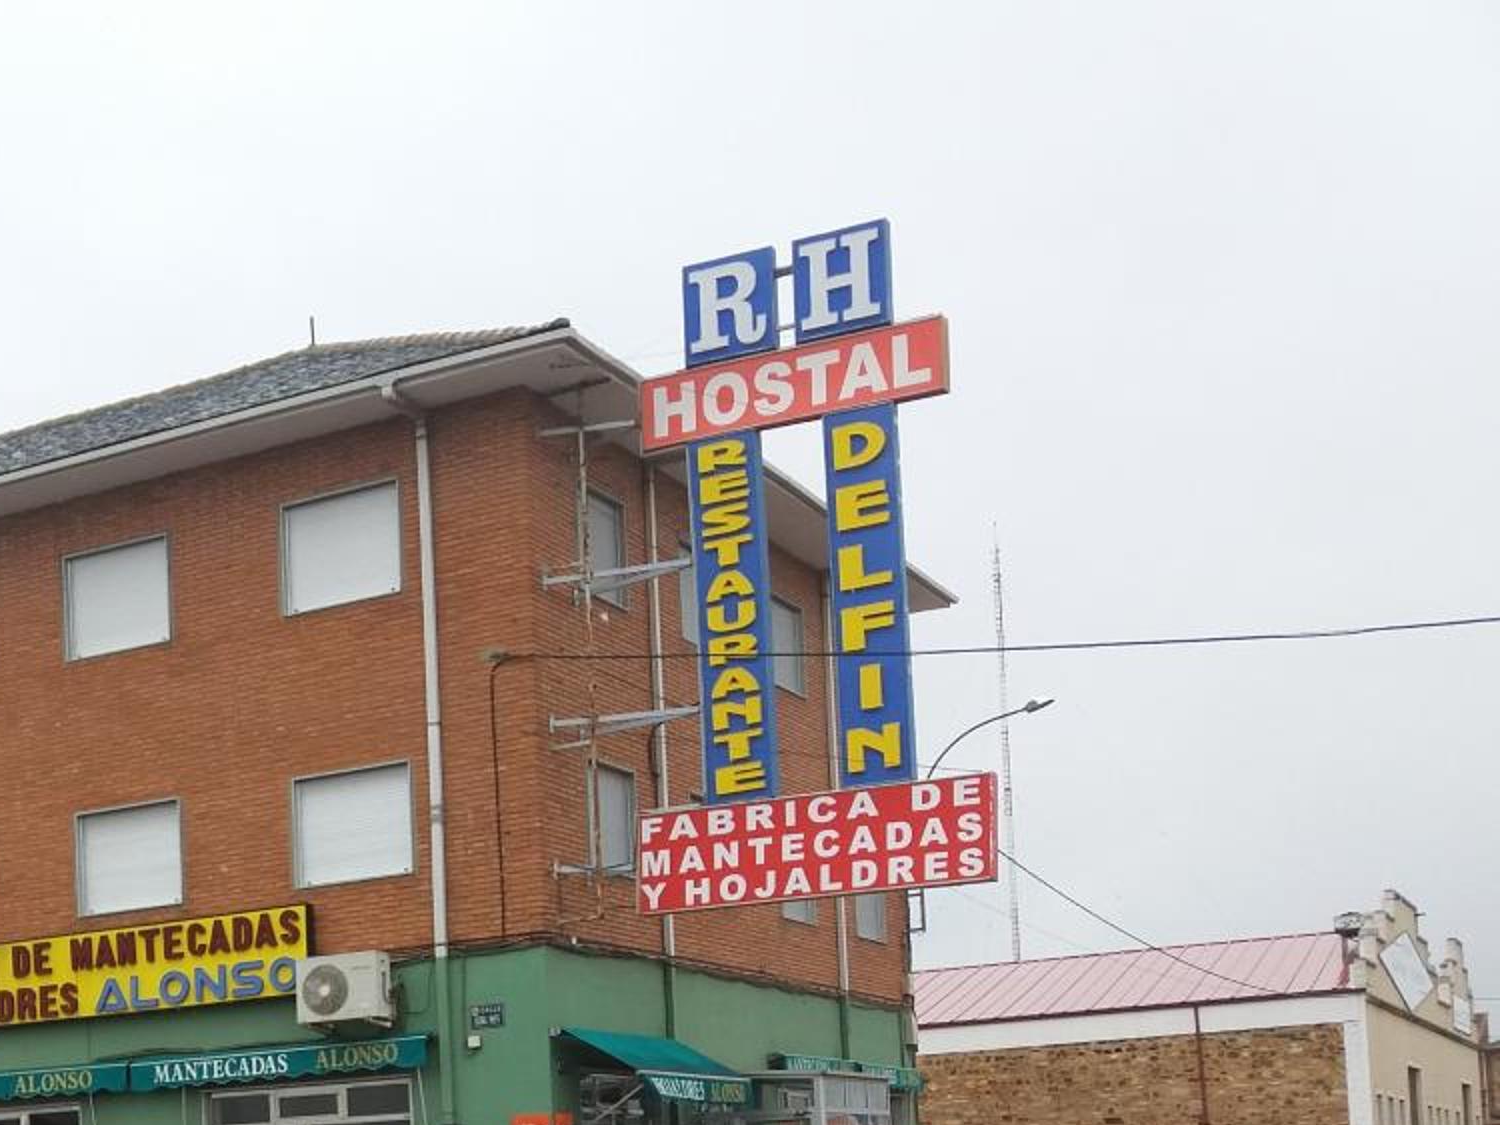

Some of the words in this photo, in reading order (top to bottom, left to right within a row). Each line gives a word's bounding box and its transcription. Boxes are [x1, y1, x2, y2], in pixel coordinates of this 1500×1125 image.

[653, 334, 933, 438] HOSTAL
[697, 439, 767, 796] RESTAURANTE
[831, 421, 902, 774] DELFIN
[640, 791, 880, 845] FABRICA
[911, 778, 982, 811] DE
[640, 813, 984, 879] MANTECADAS
[641, 885, 667, 912] Y
[684, 847, 986, 907] HOJALDRES
[11, 942, 53, 979] DE
[69, 909, 301, 973] MANTECADAS
[95, 957, 297, 1013] ALONSO
[15, 1070, 93, 1094] ALONSO
[153, 1053, 289, 1084] MANTECADAS
[314, 1043, 400, 1070] ALONSO
